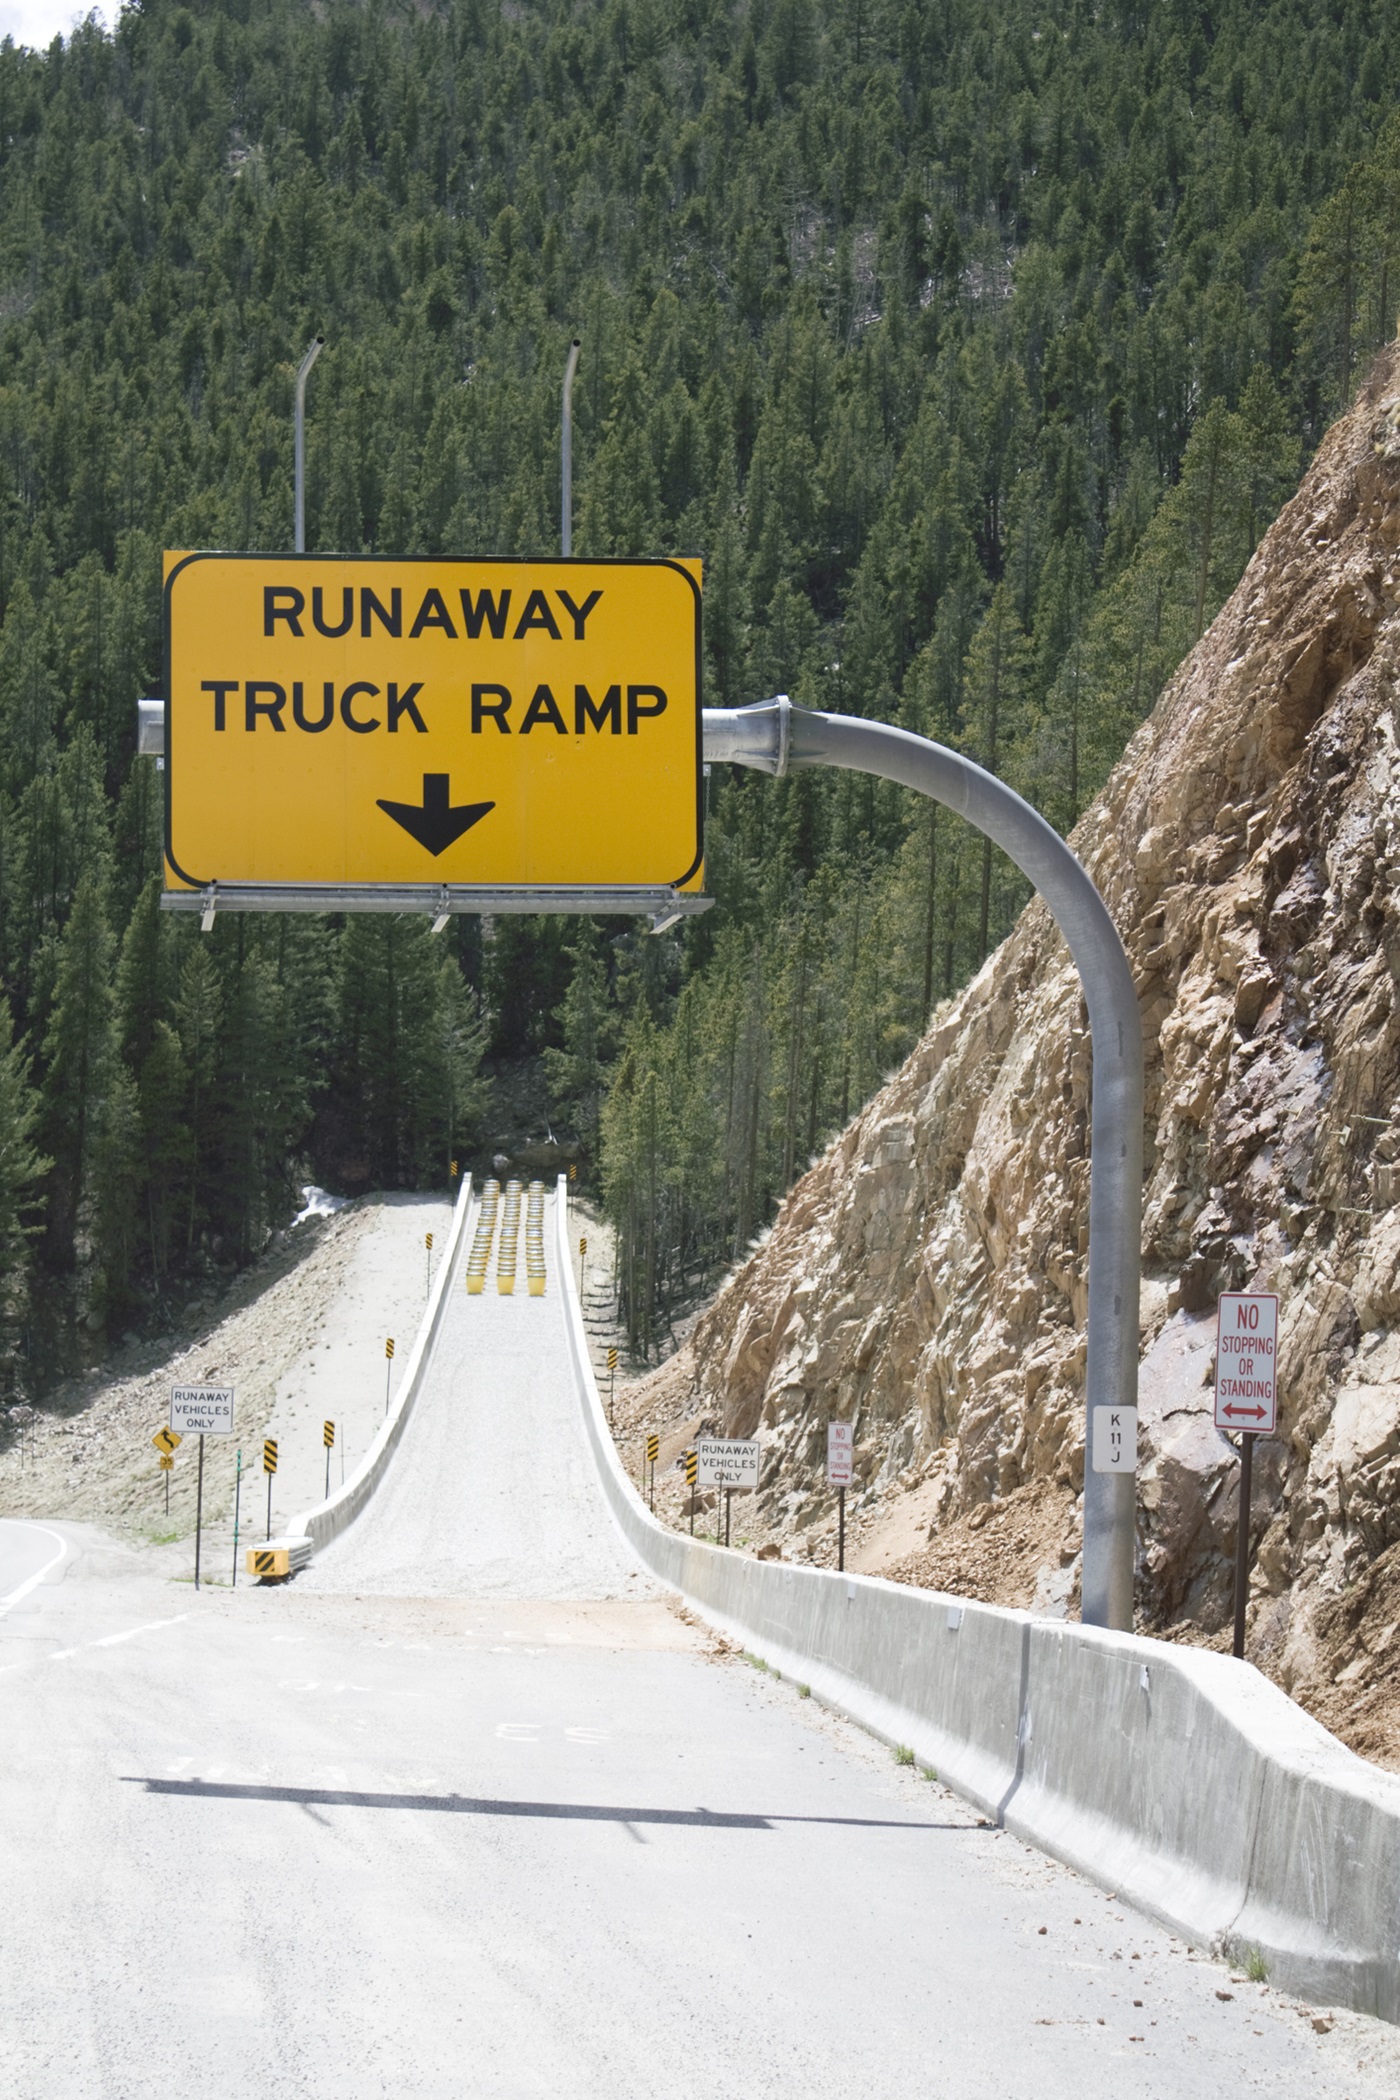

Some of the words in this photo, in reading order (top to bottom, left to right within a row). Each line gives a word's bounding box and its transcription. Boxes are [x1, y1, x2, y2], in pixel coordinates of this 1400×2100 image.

[263, 586, 604, 640] RUNAWAY
[201, 681, 429, 733] TRUCK
[471, 684, 668, 735] RAMP
[1237, 1304, 1259, 1330] NO
[1222, 1336, 1273, 1355] STOPPING
[1239, 1358, 1253, 1375] OR
[1220, 1379, 1272, 1399] STANDING
[174, 1391, 230, 1402] RUNAWAY
[174, 1405, 230, 1415] VEHICLES
[186, 1418, 215, 1428] ONLY
[1111, 1414, 1121, 1426] K
[836, 1427, 845, 1440] NO
[1111, 1433, 1121, 1444] 11
[702, 1445, 757, 1456] RUNAWAY
[830, 1441, 851, 1451] STOPPING
[162, 1457, 173, 1465] 35
[837, 1452, 844, 1460] OR
[1111, 1451, 1120, 1463] J
[701, 1458, 756, 1469] VEHICLES
[830, 1461, 851, 1471] STANDING
[714, 1471, 742, 1482] ONLY
